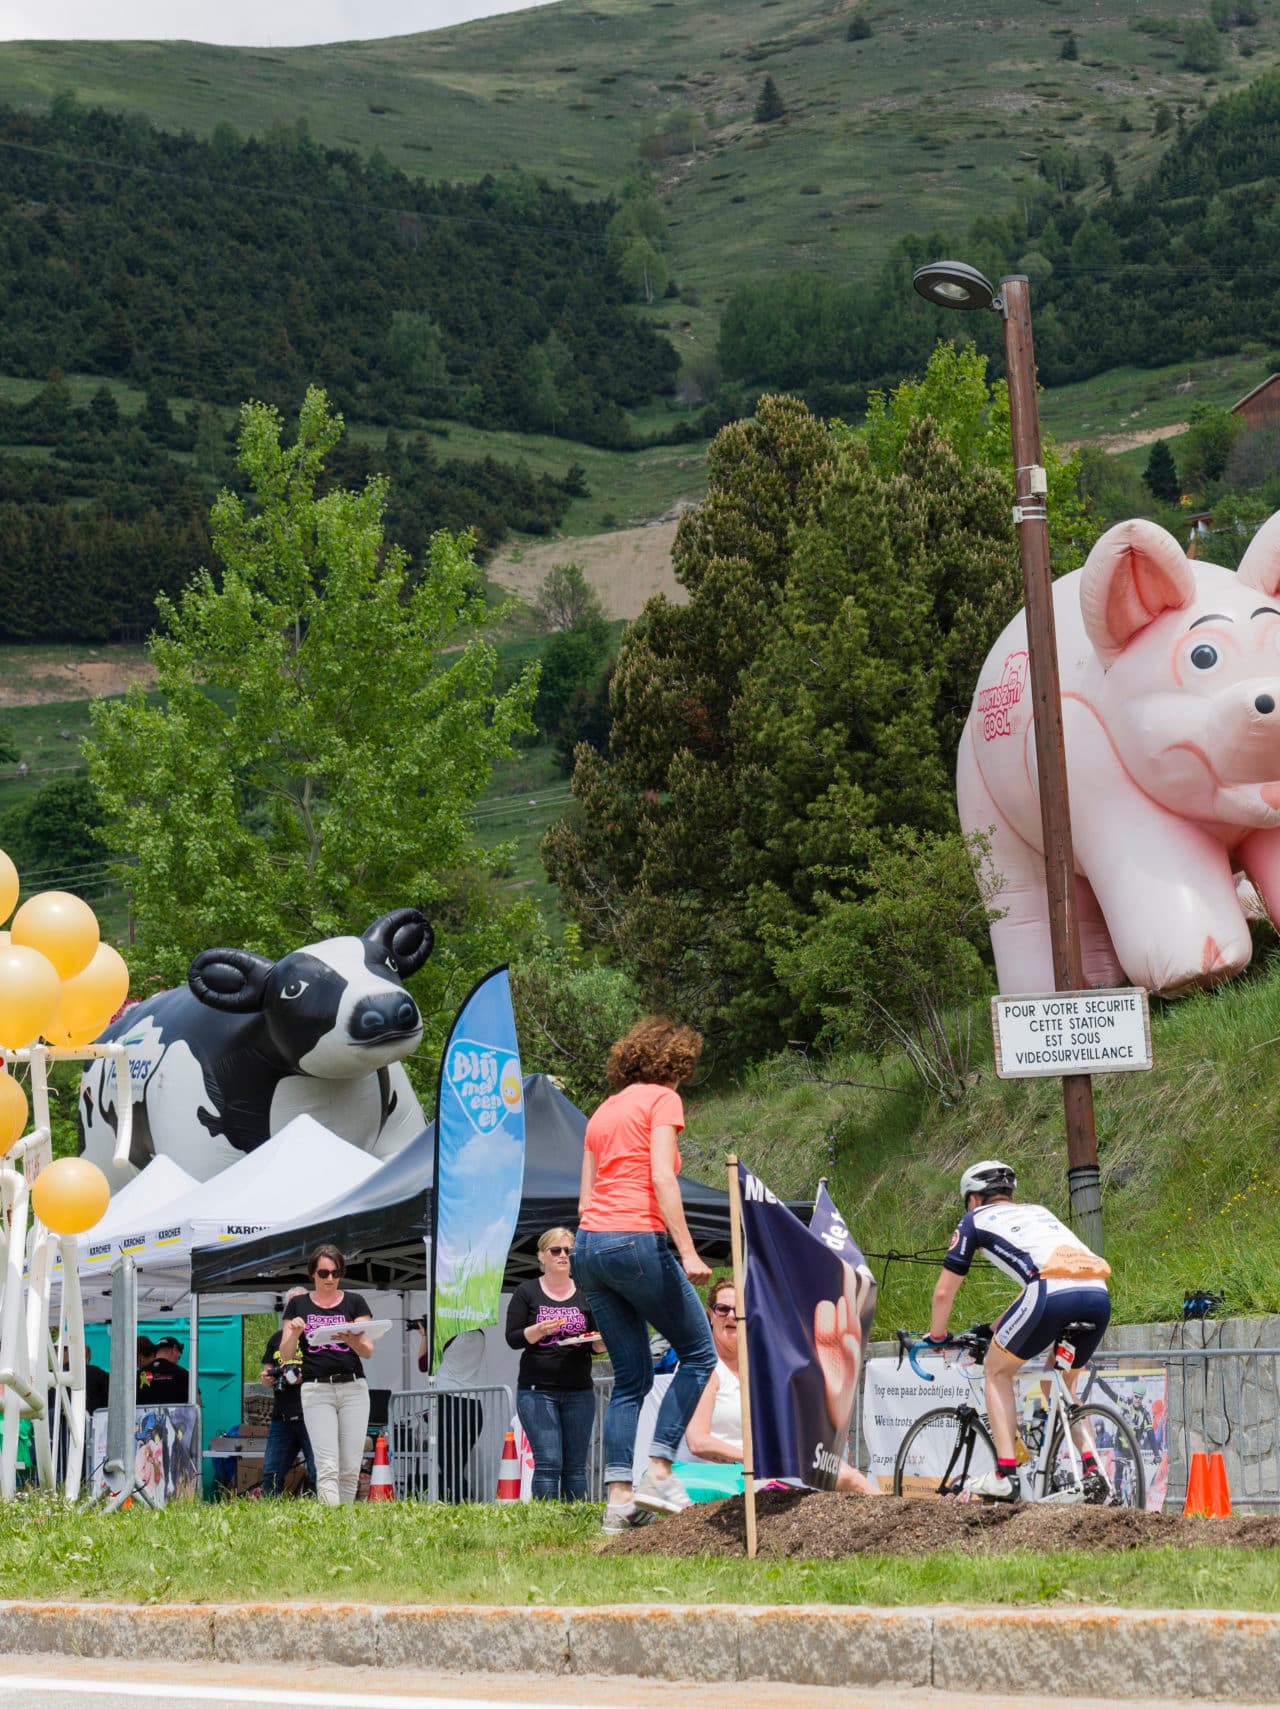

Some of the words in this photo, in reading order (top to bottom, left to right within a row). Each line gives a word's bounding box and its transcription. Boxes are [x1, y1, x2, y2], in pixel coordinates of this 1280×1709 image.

[983, 708, 1011, 741] COOL
[1005, 1004, 1036, 1018] POUR
[1042, 1002, 1079, 1016] VOTRE
[1085, 999, 1136, 1014] SECURITE
[1029, 1018, 1063, 1032] CETTE
[1069, 1015, 1115, 1030] STATION
[1045, 1034, 1063, 1047] EST
[1071, 1032, 1101, 1045] SOUS
[1015, 1045, 1134, 1064] VIDEOSURVEILLANCE
[886, 1386, 900, 1396] een
[900, 1386, 917, 1399] paar
